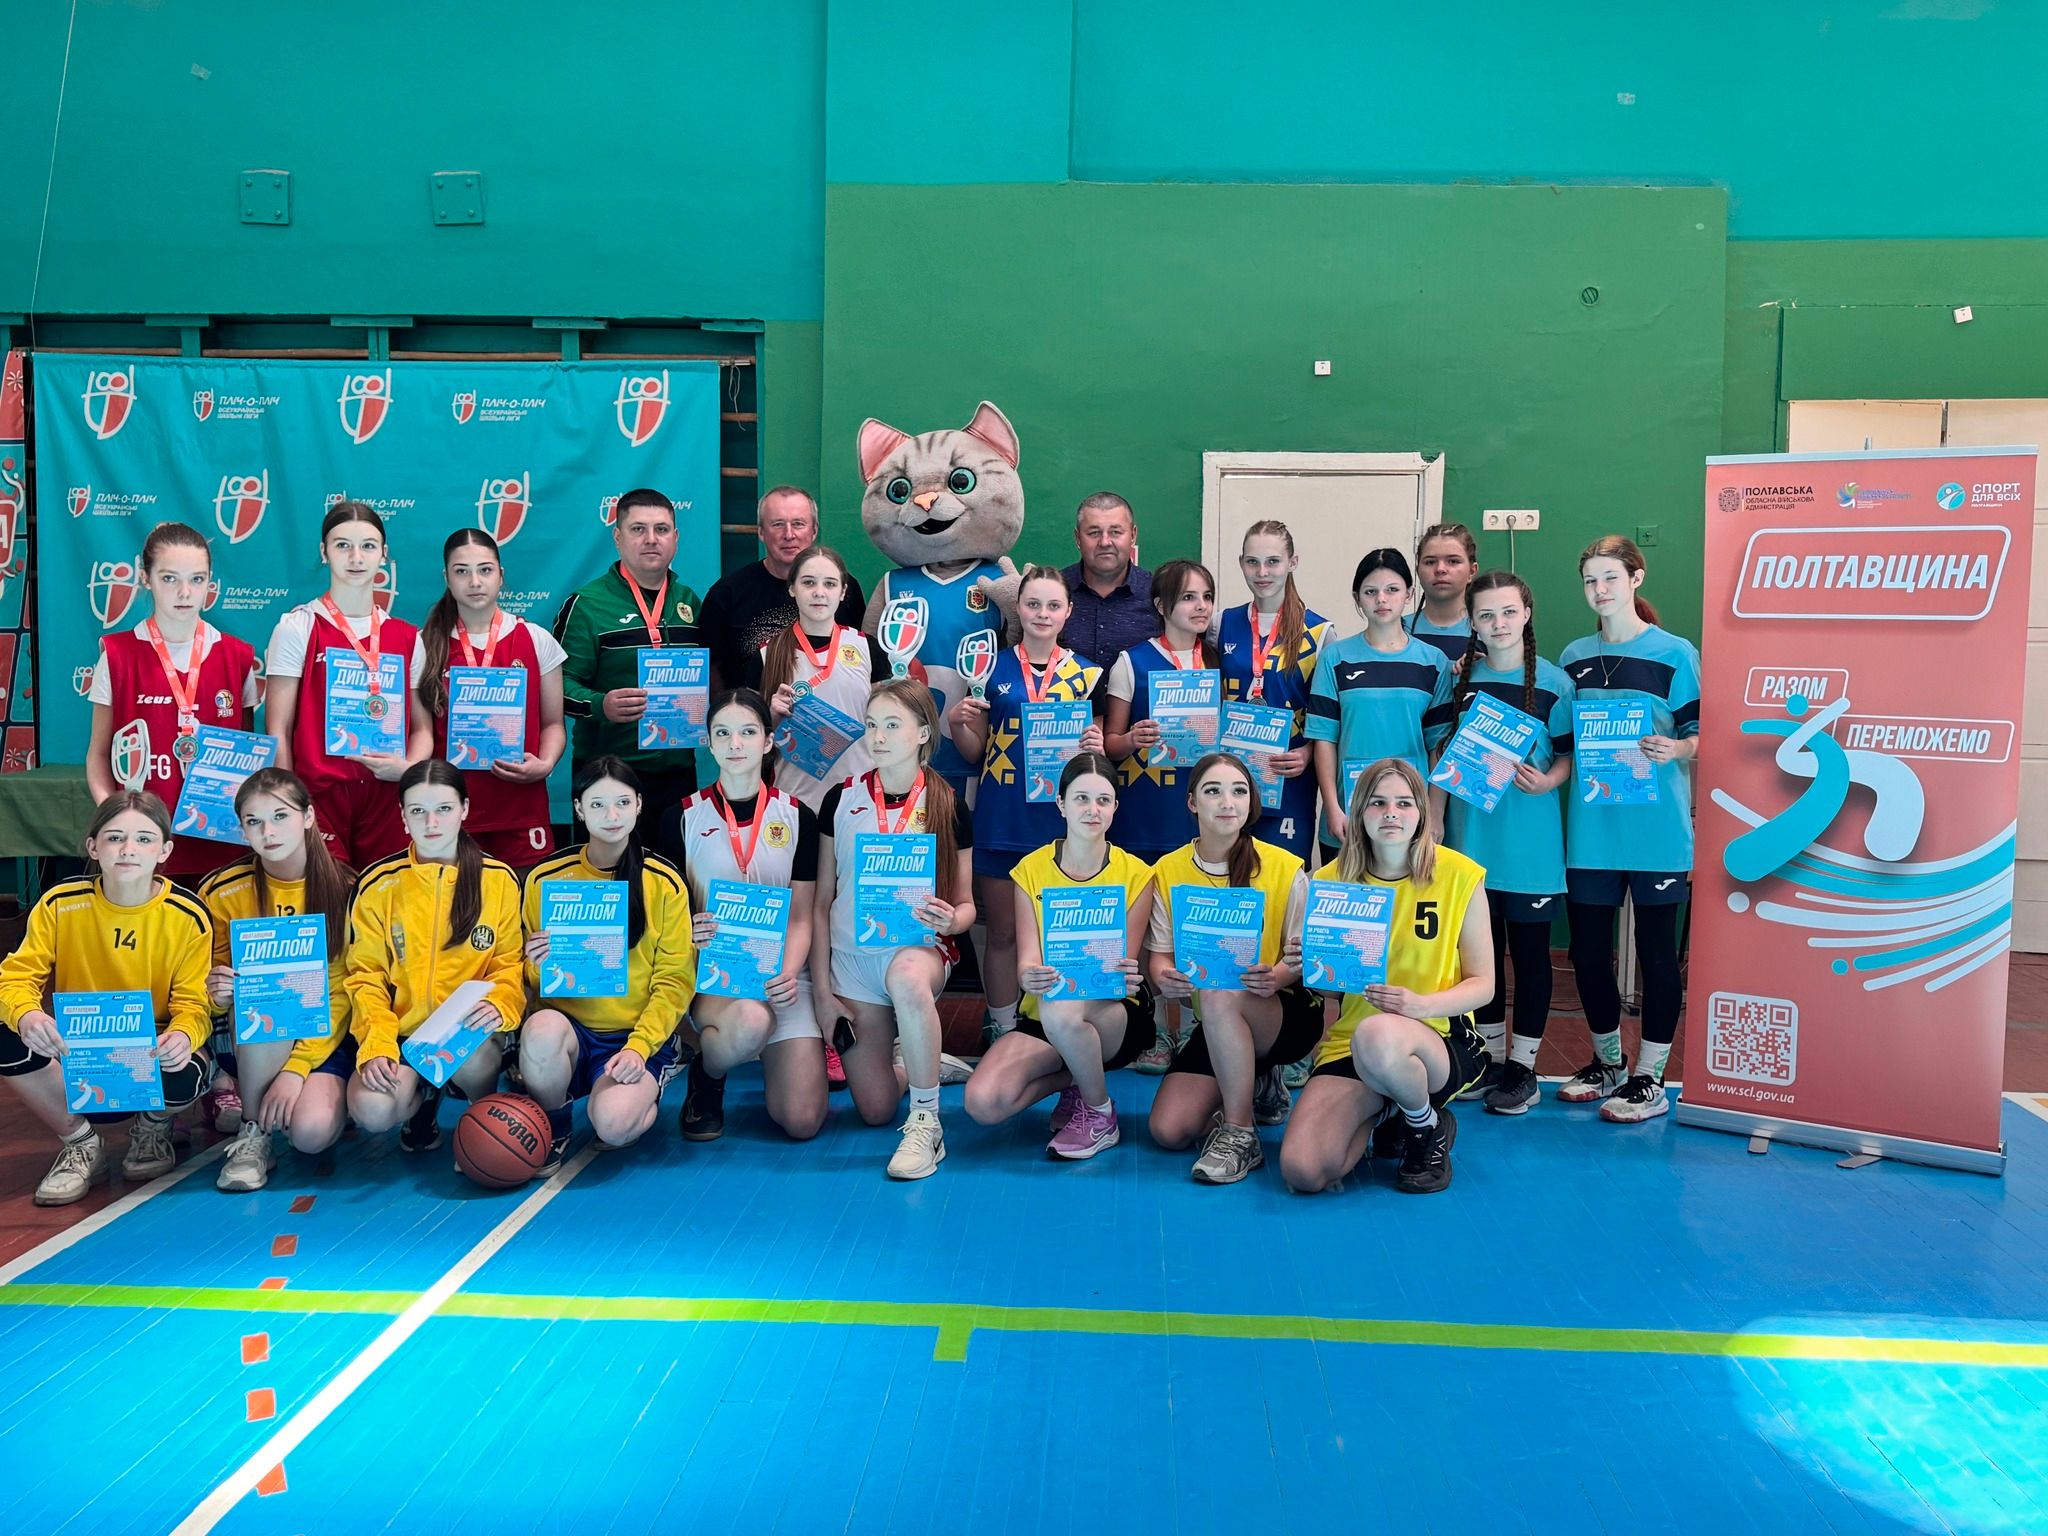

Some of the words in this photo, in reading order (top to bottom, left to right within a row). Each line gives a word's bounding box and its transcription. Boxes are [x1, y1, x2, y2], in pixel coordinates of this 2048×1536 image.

[1745, 486, 1813, 496] ПОЛТАВСЬКА
[1971, 493, 1994, 503] ДЛЯ
[1996, 493, 2021, 501] ВСІХ
[1972, 483, 2021, 493] СПОРТ
[1751, 554, 1989, 593] ПОЛТАВЩИНА
[497, 591, 550, 601] ЛІЧ-О-ПЛІЧ
[370, 673, 376, 681] 2
[645, 667, 701, 684] ДИПЛОМ
[455, 686, 517, 702] ДИПЛОМ
[1155, 688, 1212, 706] ДИПЛОМ
[1761, 675, 1829, 700] РАЗОМ
[184, 716, 190, 724] 2
[1029, 719, 1084, 737] ДИПЛОМ
[1581, 719, 1641, 738] ДИПЛОМ
[1225, 720, 1282, 742] ДИПЛОМ
[1468, 713, 1526, 748] ДИПЛОМ
[1846, 723, 1992, 754] ПЕРЕМОЖЕМО
[198, 747, 265, 771] ДИПЛОМ
[1279, 817, 1296, 840] 4
[862, 855, 926, 873] ДИПЛОМ
[549, 903, 617, 922] ДИПЛОМ
[712, 902, 779, 926] ДИПЛОМ
[1051, 908, 1116, 928] ДИПЛОМ
[1186, 905, 1253, 925] ДИПЛОМ
[1313, 898, 1382, 918] ДИПЛОМ
[1414, 901, 1439, 940] 5
[114, 927, 137, 951] 14
[241, 937, 315, 963] ДИПЛОМ
[66, 1014, 142, 1036] ДИПЛОМ
[1707, 1082, 1795, 1104] www.scl.gov.ua
[487, 1105, 539, 1156] Wilson
